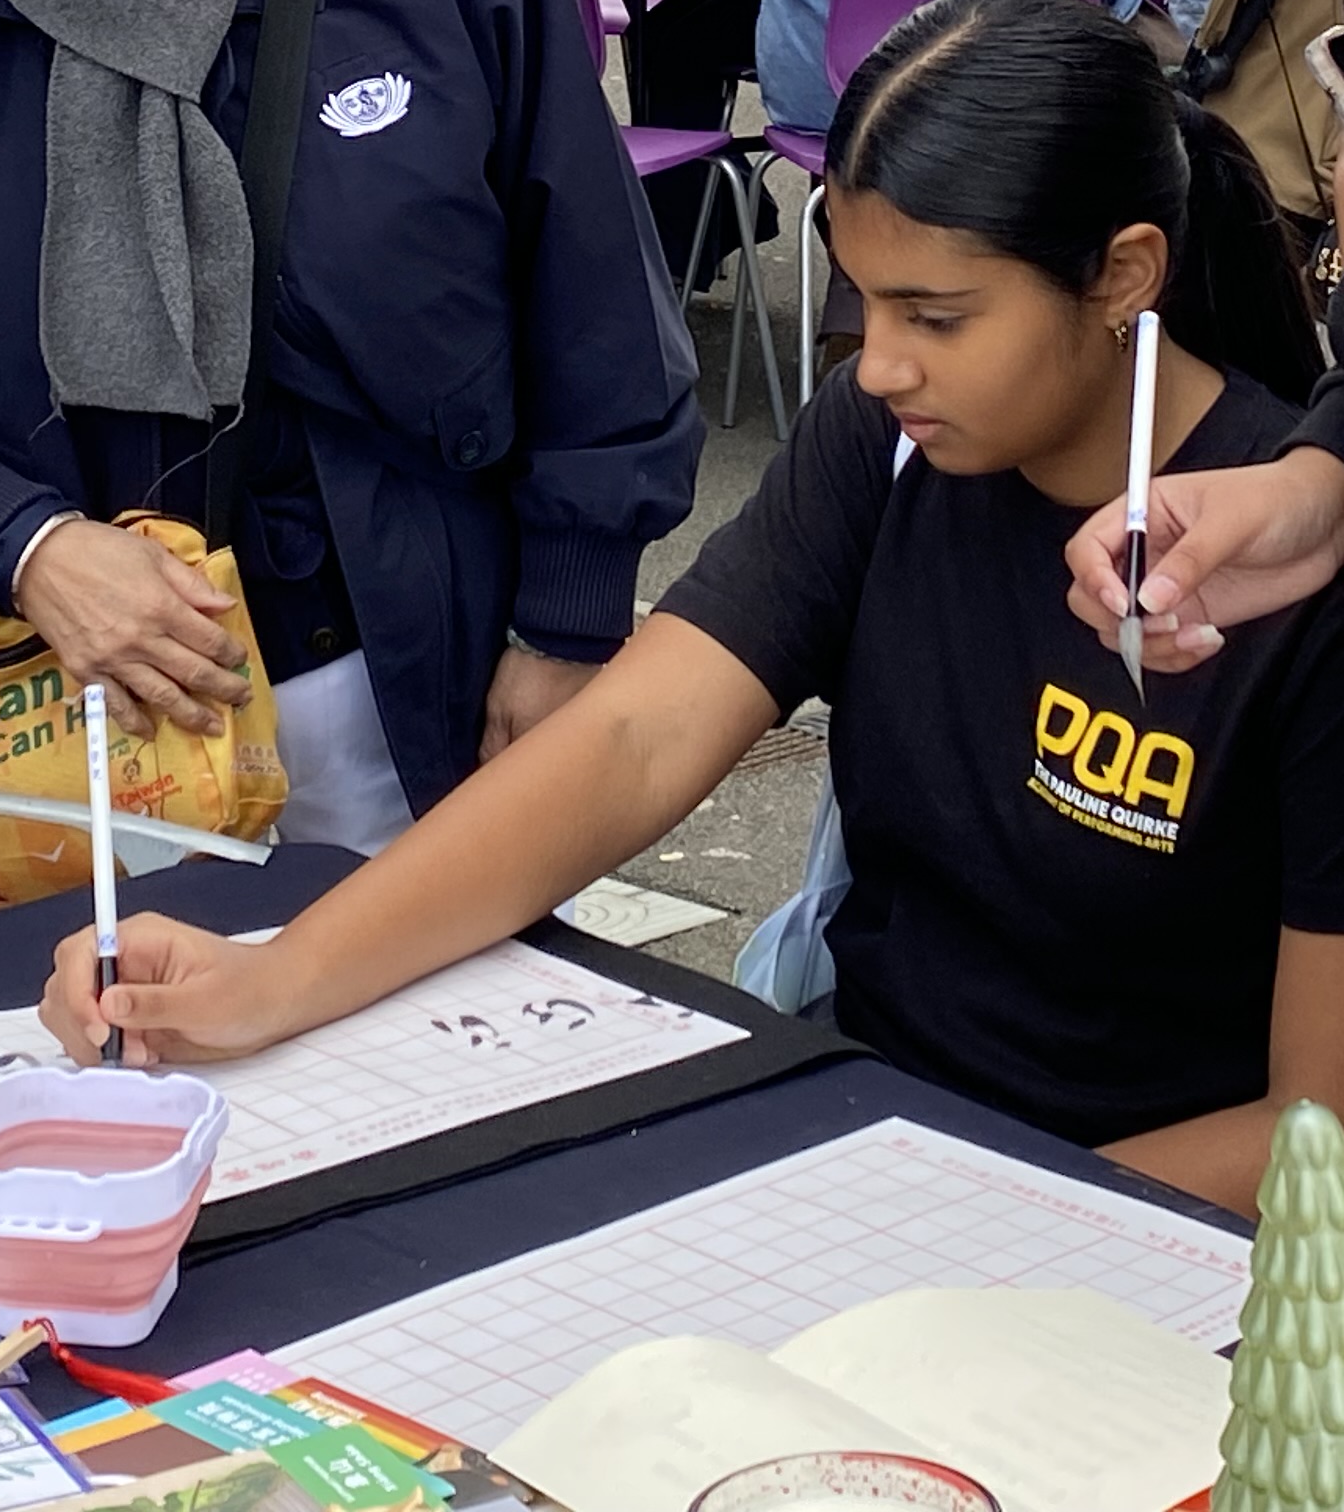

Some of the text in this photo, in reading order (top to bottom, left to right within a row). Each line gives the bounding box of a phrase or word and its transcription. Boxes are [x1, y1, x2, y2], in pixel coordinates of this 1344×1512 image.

[1049, 775, 1109, 817] PAULINE
[1111, 804, 1180, 840] QUIRKE
[1073, 810, 1143, 846] PERFORMING
[1145, 835, 1175, 854] ARTS
